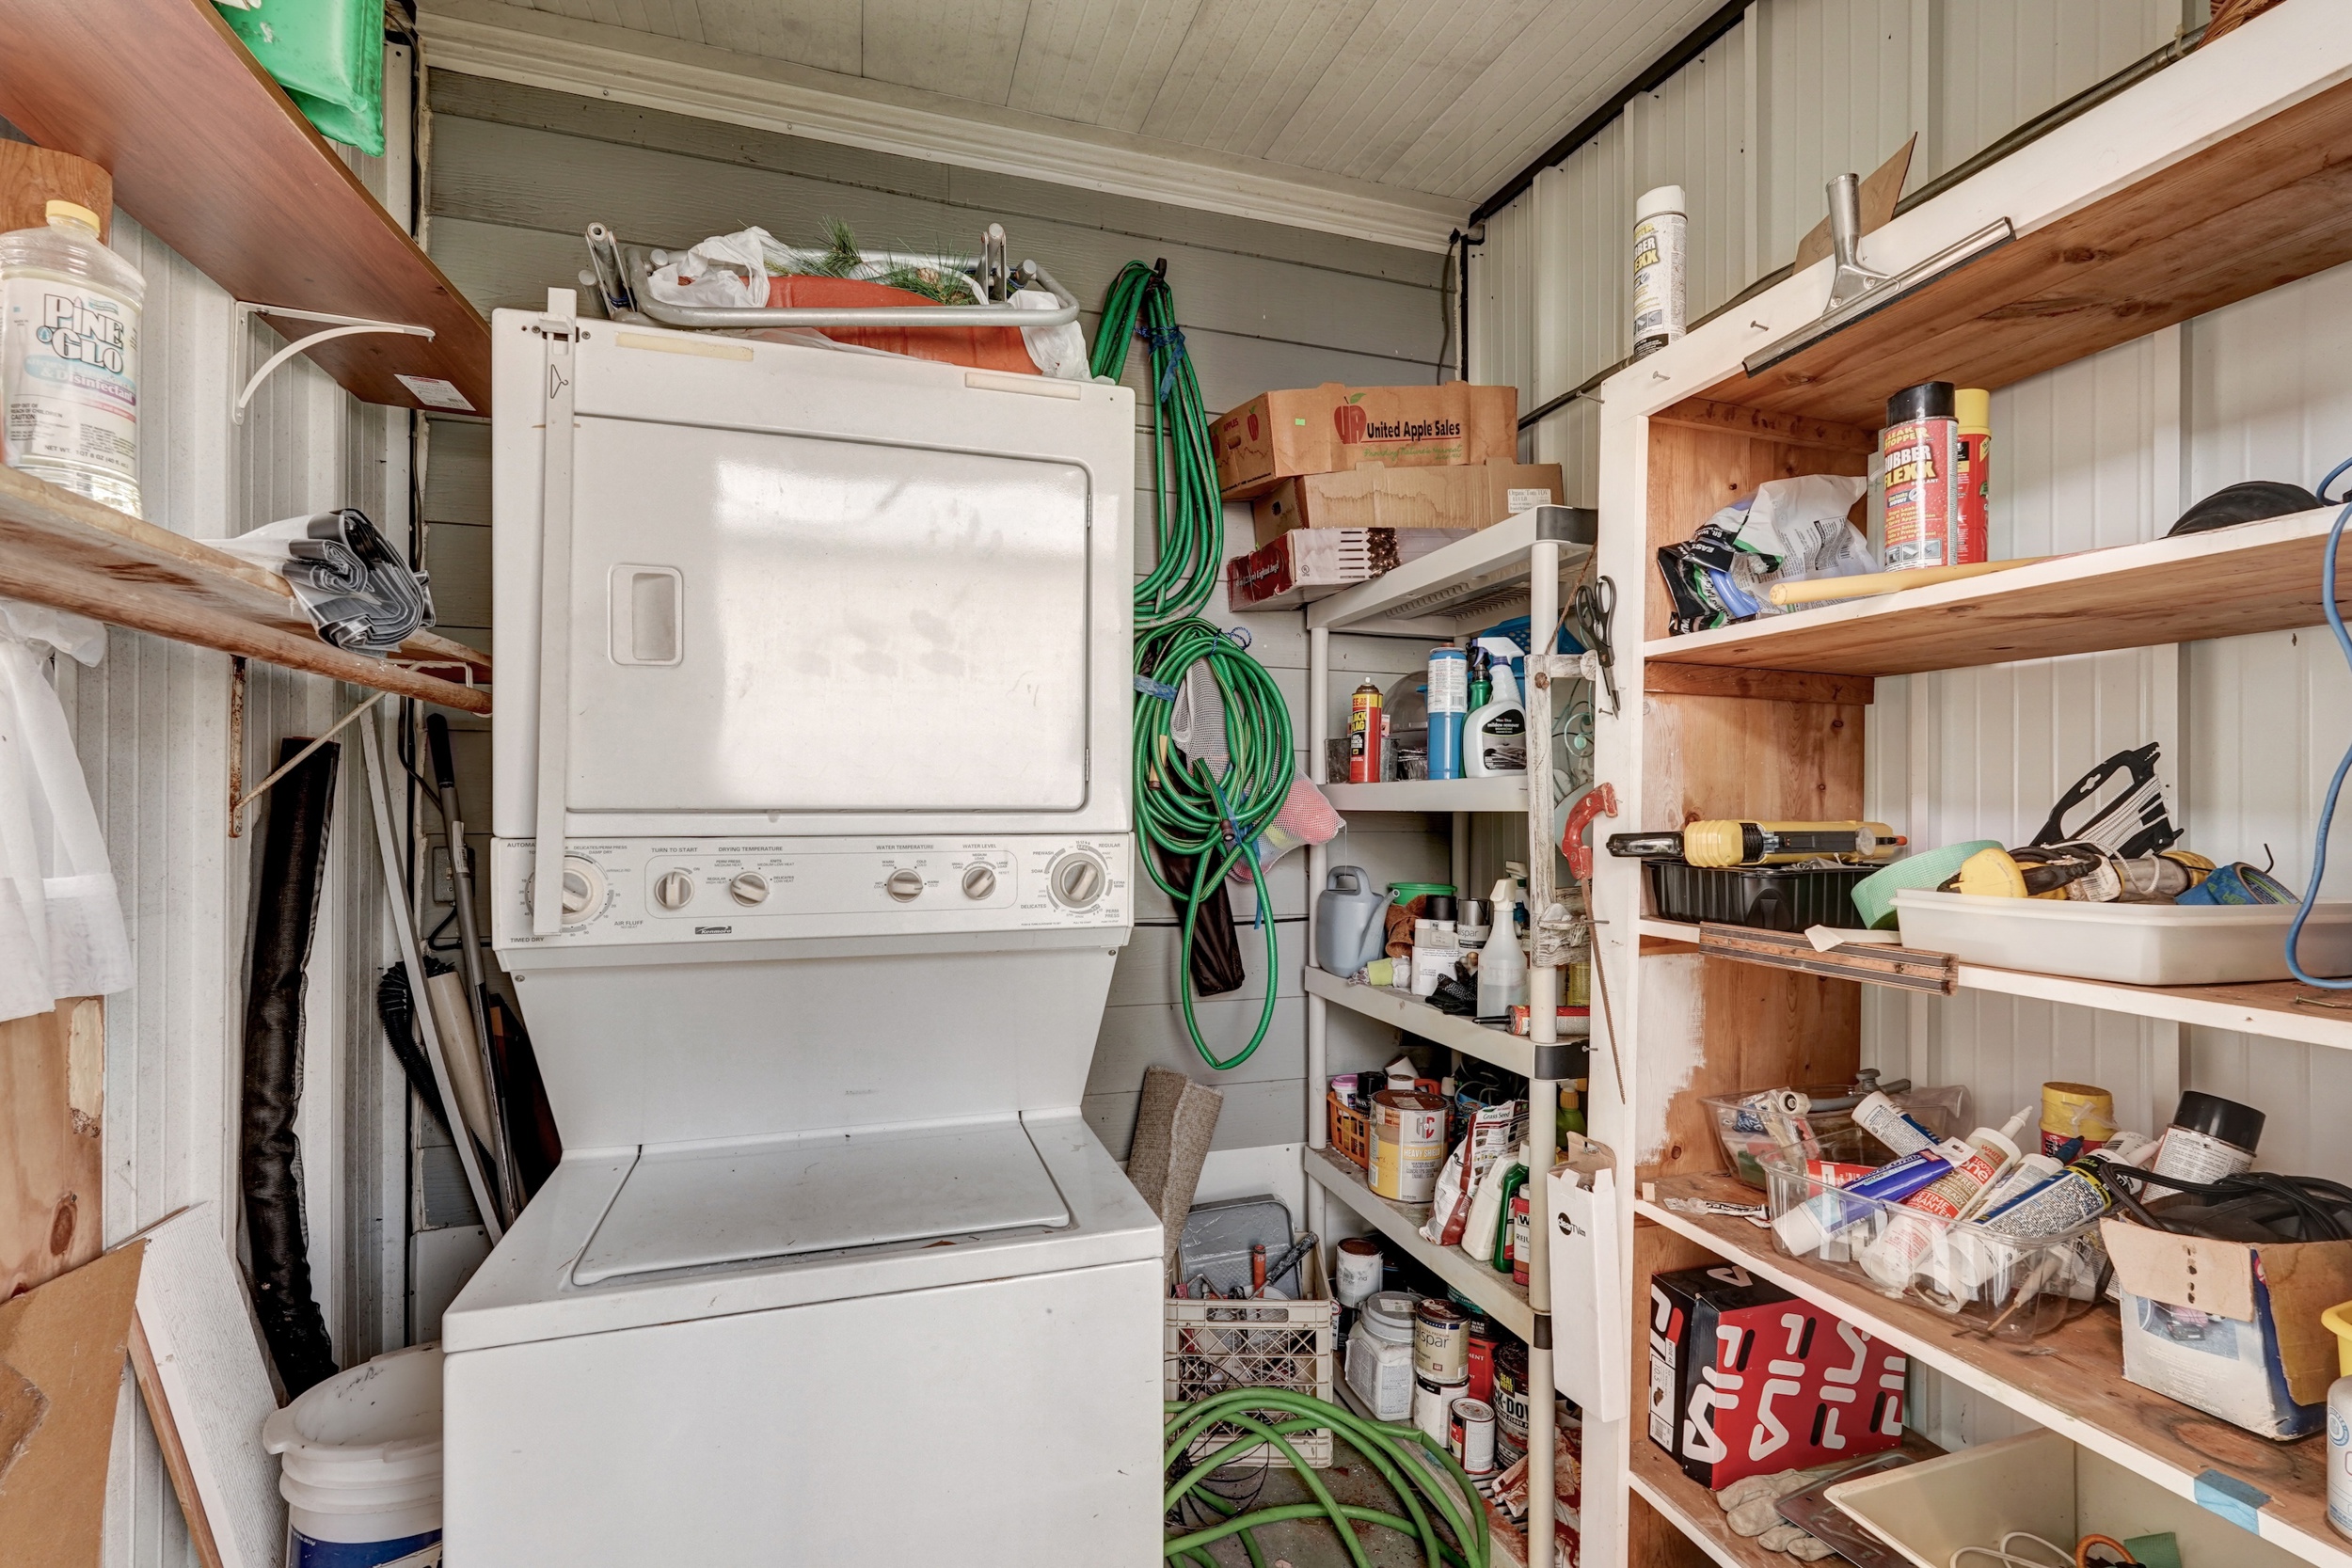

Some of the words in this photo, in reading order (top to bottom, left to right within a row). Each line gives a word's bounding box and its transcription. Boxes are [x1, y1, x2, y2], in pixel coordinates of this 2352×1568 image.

[44, 293, 124, 350] PINE
[52, 326, 123, 374] GLO
[1366, 420, 1401, 439] United
[1403, 419, 1433, 442] Apple
[1434, 419, 1461, 436] Sales
[1886, 426, 1915, 439] LEAK
[701, 926, 732, 935] Kenmore
[1457, 927, 1479, 938] alspar
[1499, 1111, 1510, 1119] Seed
[1404, 1148, 1422, 1158] HEAVY
[1423, 1148, 1441, 1158] SHIELD
[1980, 1144, 2005, 1164] WHITE
[1961, 1159, 1989, 1182] one
[1974, 1157, 1994, 1176] 100%
[1516, 1232, 1530, 1243] REJU
[1416, 1325, 1450, 1349] alspar
[1681, 1323, 1756, 1465] FILA
[1748, 1312, 1817, 1462] FILA
